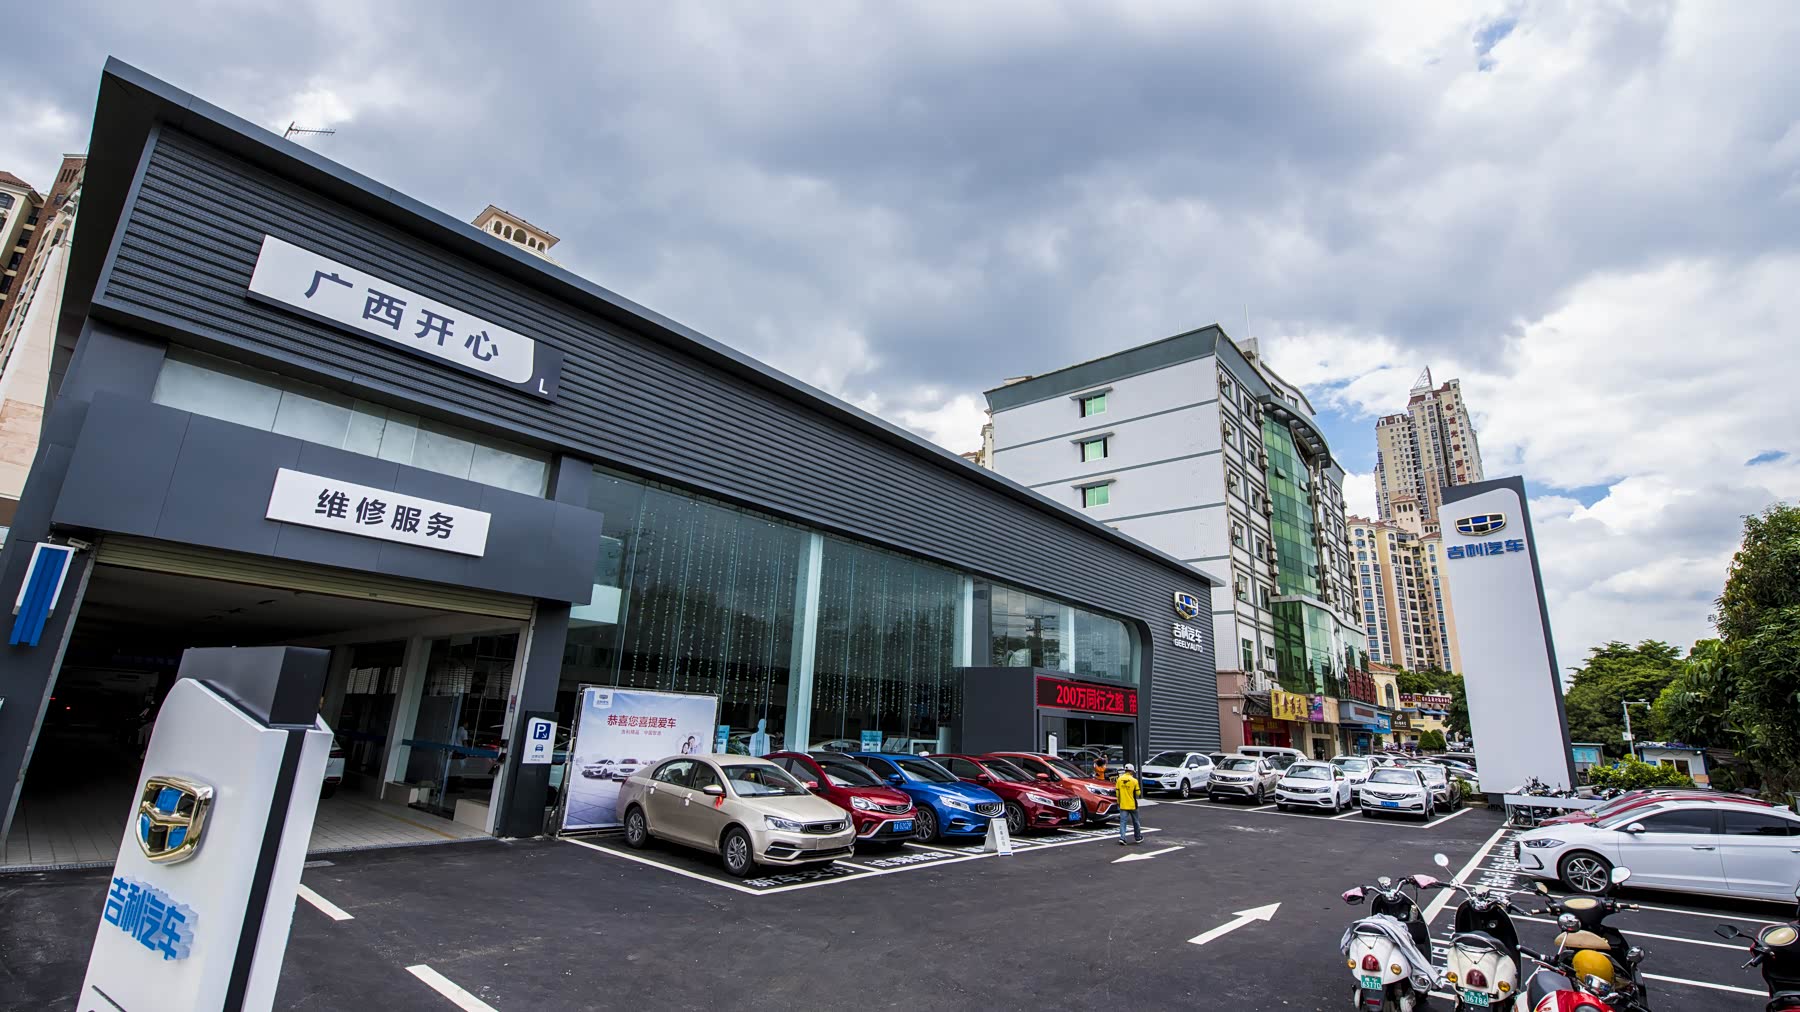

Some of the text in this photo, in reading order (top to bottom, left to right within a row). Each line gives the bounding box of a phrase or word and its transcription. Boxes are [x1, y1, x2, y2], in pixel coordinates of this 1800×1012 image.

[303, 269, 500, 363] 广西开心
[314, 488, 456, 540] 维修服务
[1447, 538, 1525, 560] 吉利汽车
[1172, 622, 1203, 643] 吉利汽车
[1056, 685, 1124, 712] 200万同行之路
[536, 724, 547, 738] P
[607, 714, 677, 729] 恭喜您喜提爱车
[104, 877, 186, 961] 吉利汽车
